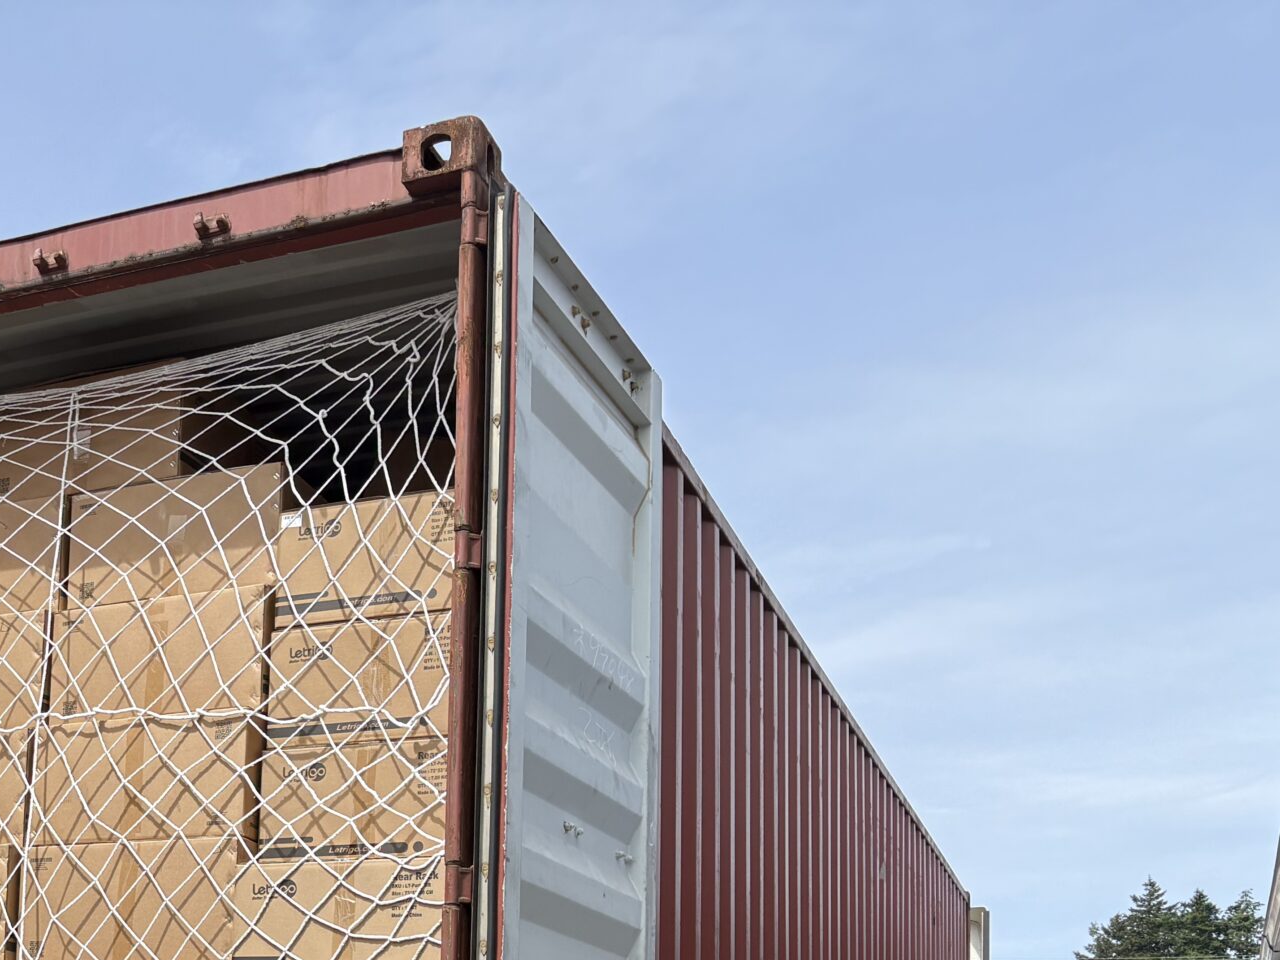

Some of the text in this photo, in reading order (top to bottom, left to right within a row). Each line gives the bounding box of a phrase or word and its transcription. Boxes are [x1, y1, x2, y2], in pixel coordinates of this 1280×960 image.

[282, 763, 326, 781] Lerigo
[328, 846, 382, 855] Letrigo.c
[252, 879, 297, 898] Letgo
